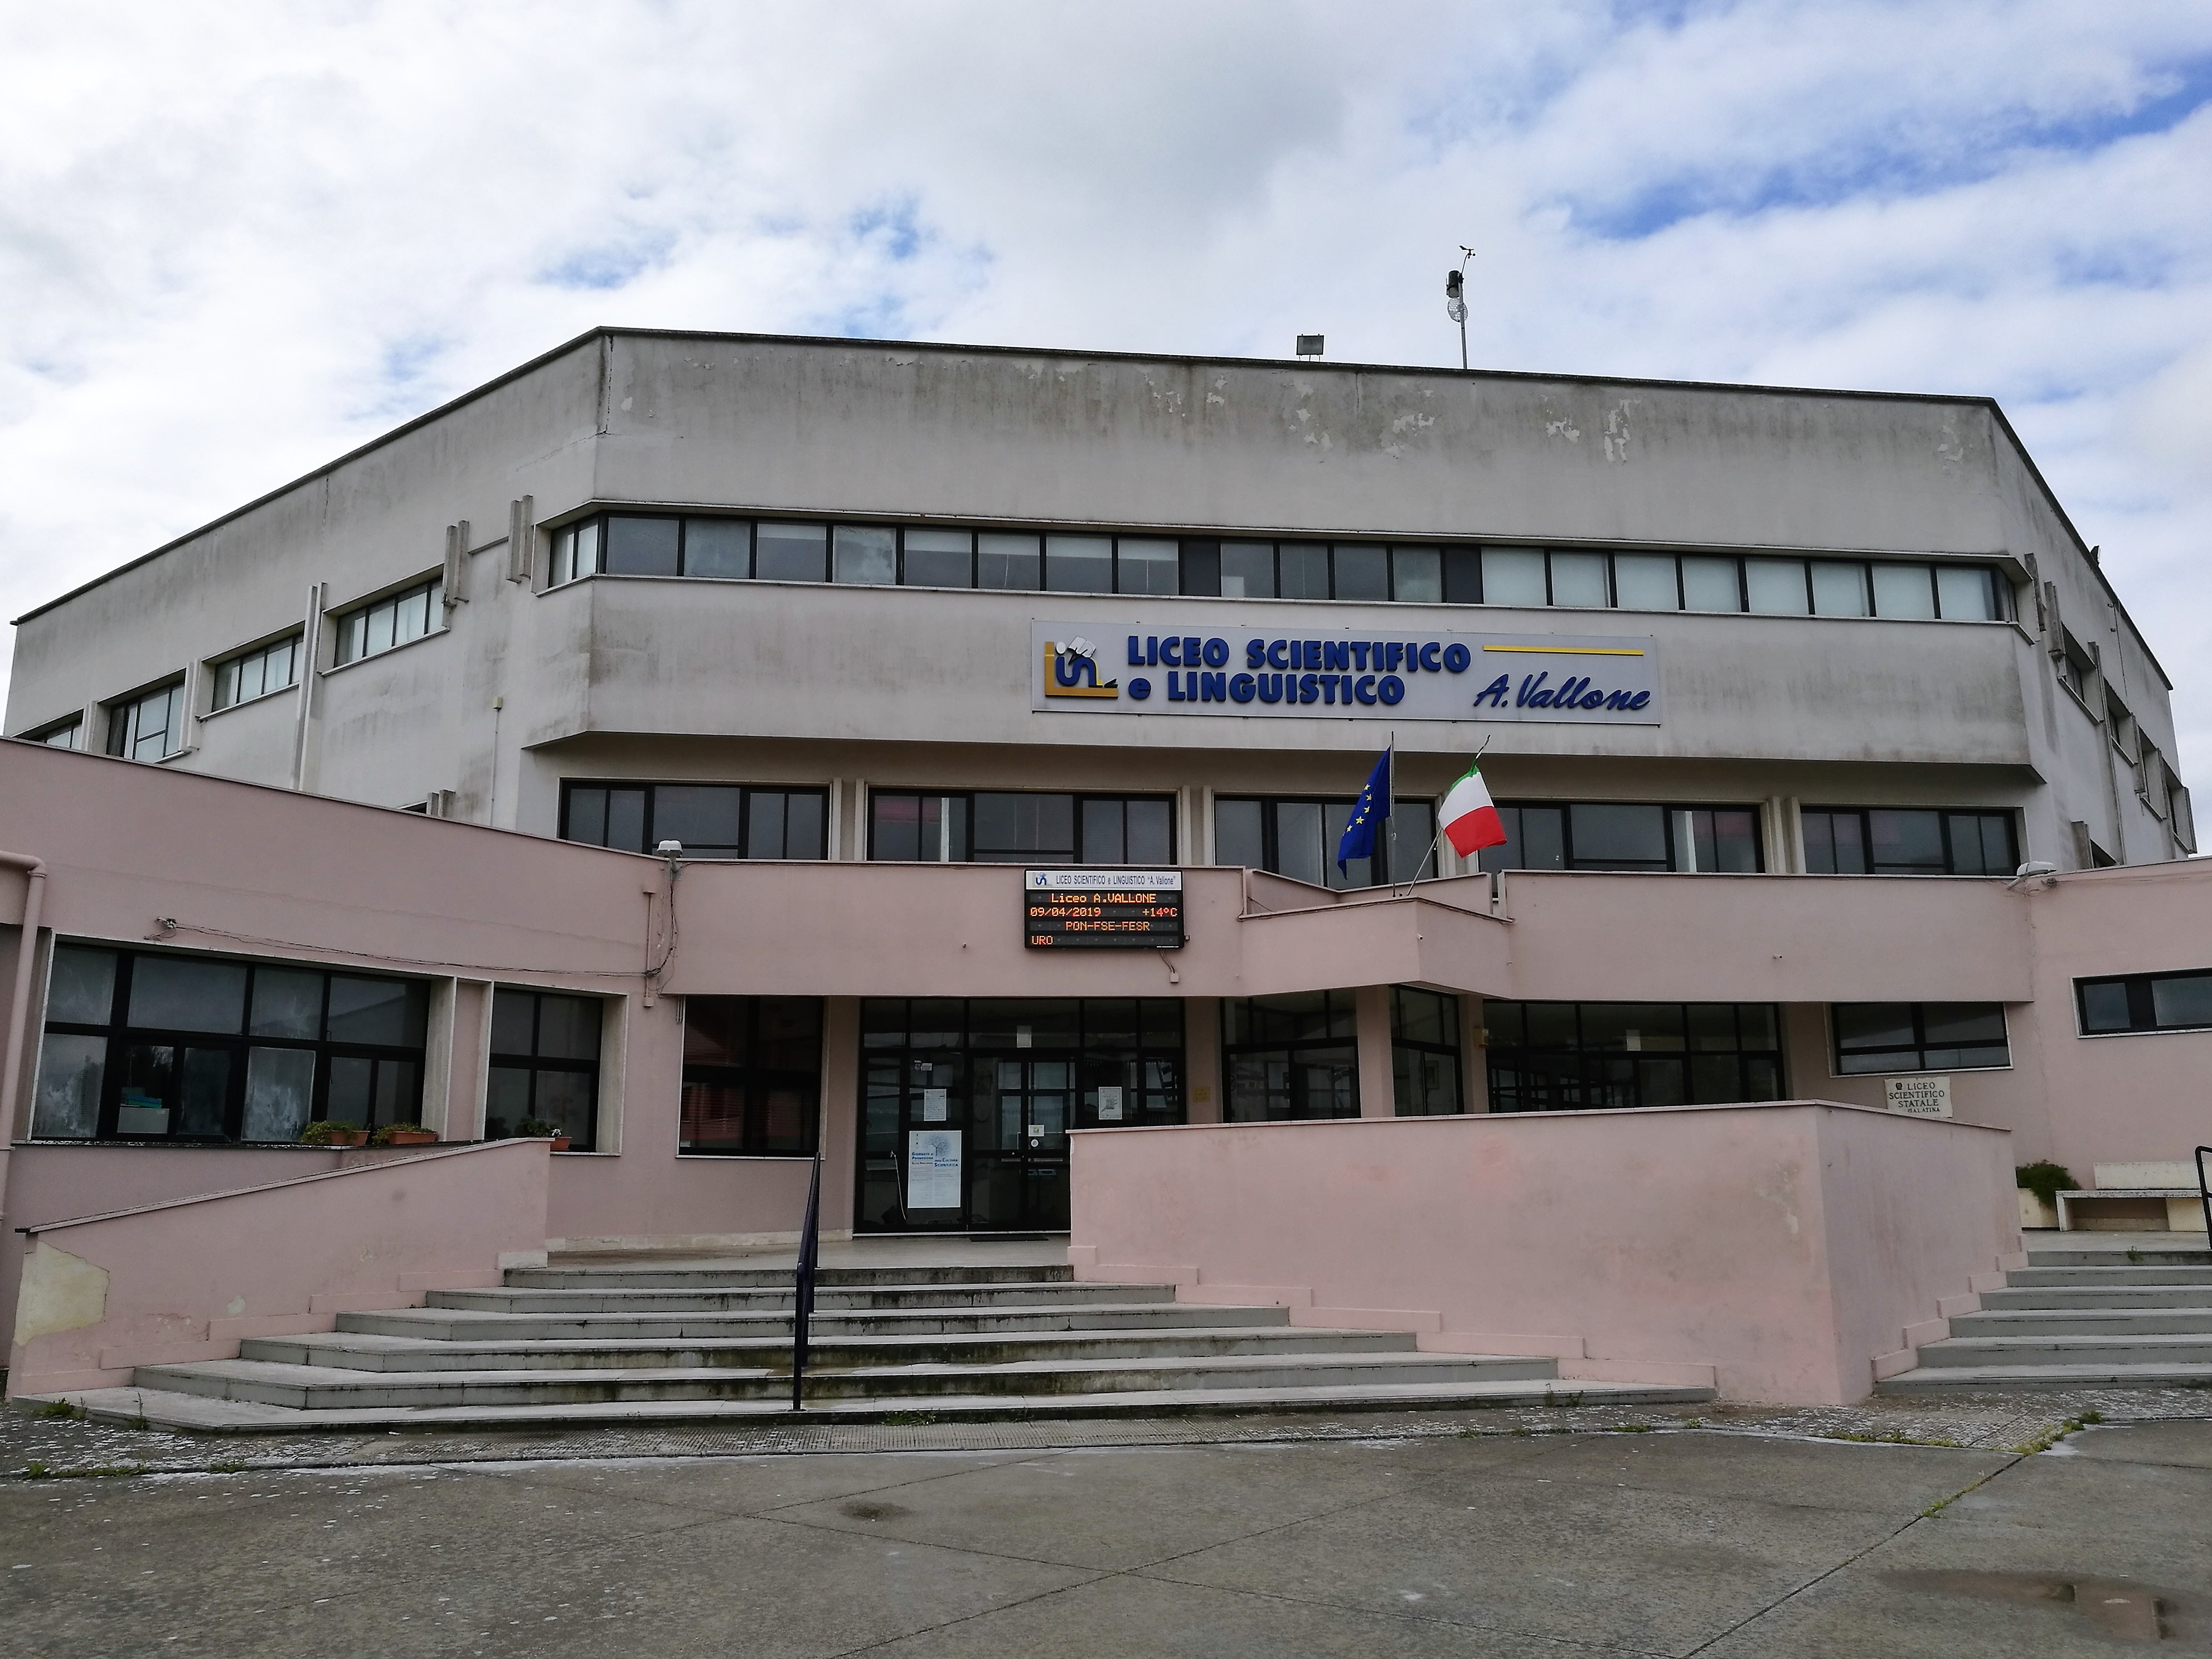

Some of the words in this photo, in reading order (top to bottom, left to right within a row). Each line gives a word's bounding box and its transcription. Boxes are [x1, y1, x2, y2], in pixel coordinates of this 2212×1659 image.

[1128, 636, 1230, 667] LICEO
[1246, 638, 1472, 673] SCIENTIFICO
[1128, 677, 1152, 700] e
[1168, 671, 1405, 705] LINGUISTICO
[1056, 875, 1071, 884] LICEO
[1074, 875, 1105, 885] SCIENTIFICO
[1113, 876, 1145, 885] LINGUISTICO
[1051, 893, 1087, 903] Liceo
[1093, 893, 1157, 903] A.VALLONE
[1030, 907, 1101, 916] 09/04/2019
[1065, 921, 1150, 931] PON-FSE-FESR
[1907, 1082, 1936, 1090] LICEO
[1889, 1090, 1944, 1099] SCIENTIFICO
[1898, 1099, 1939, 1108] STATALE
